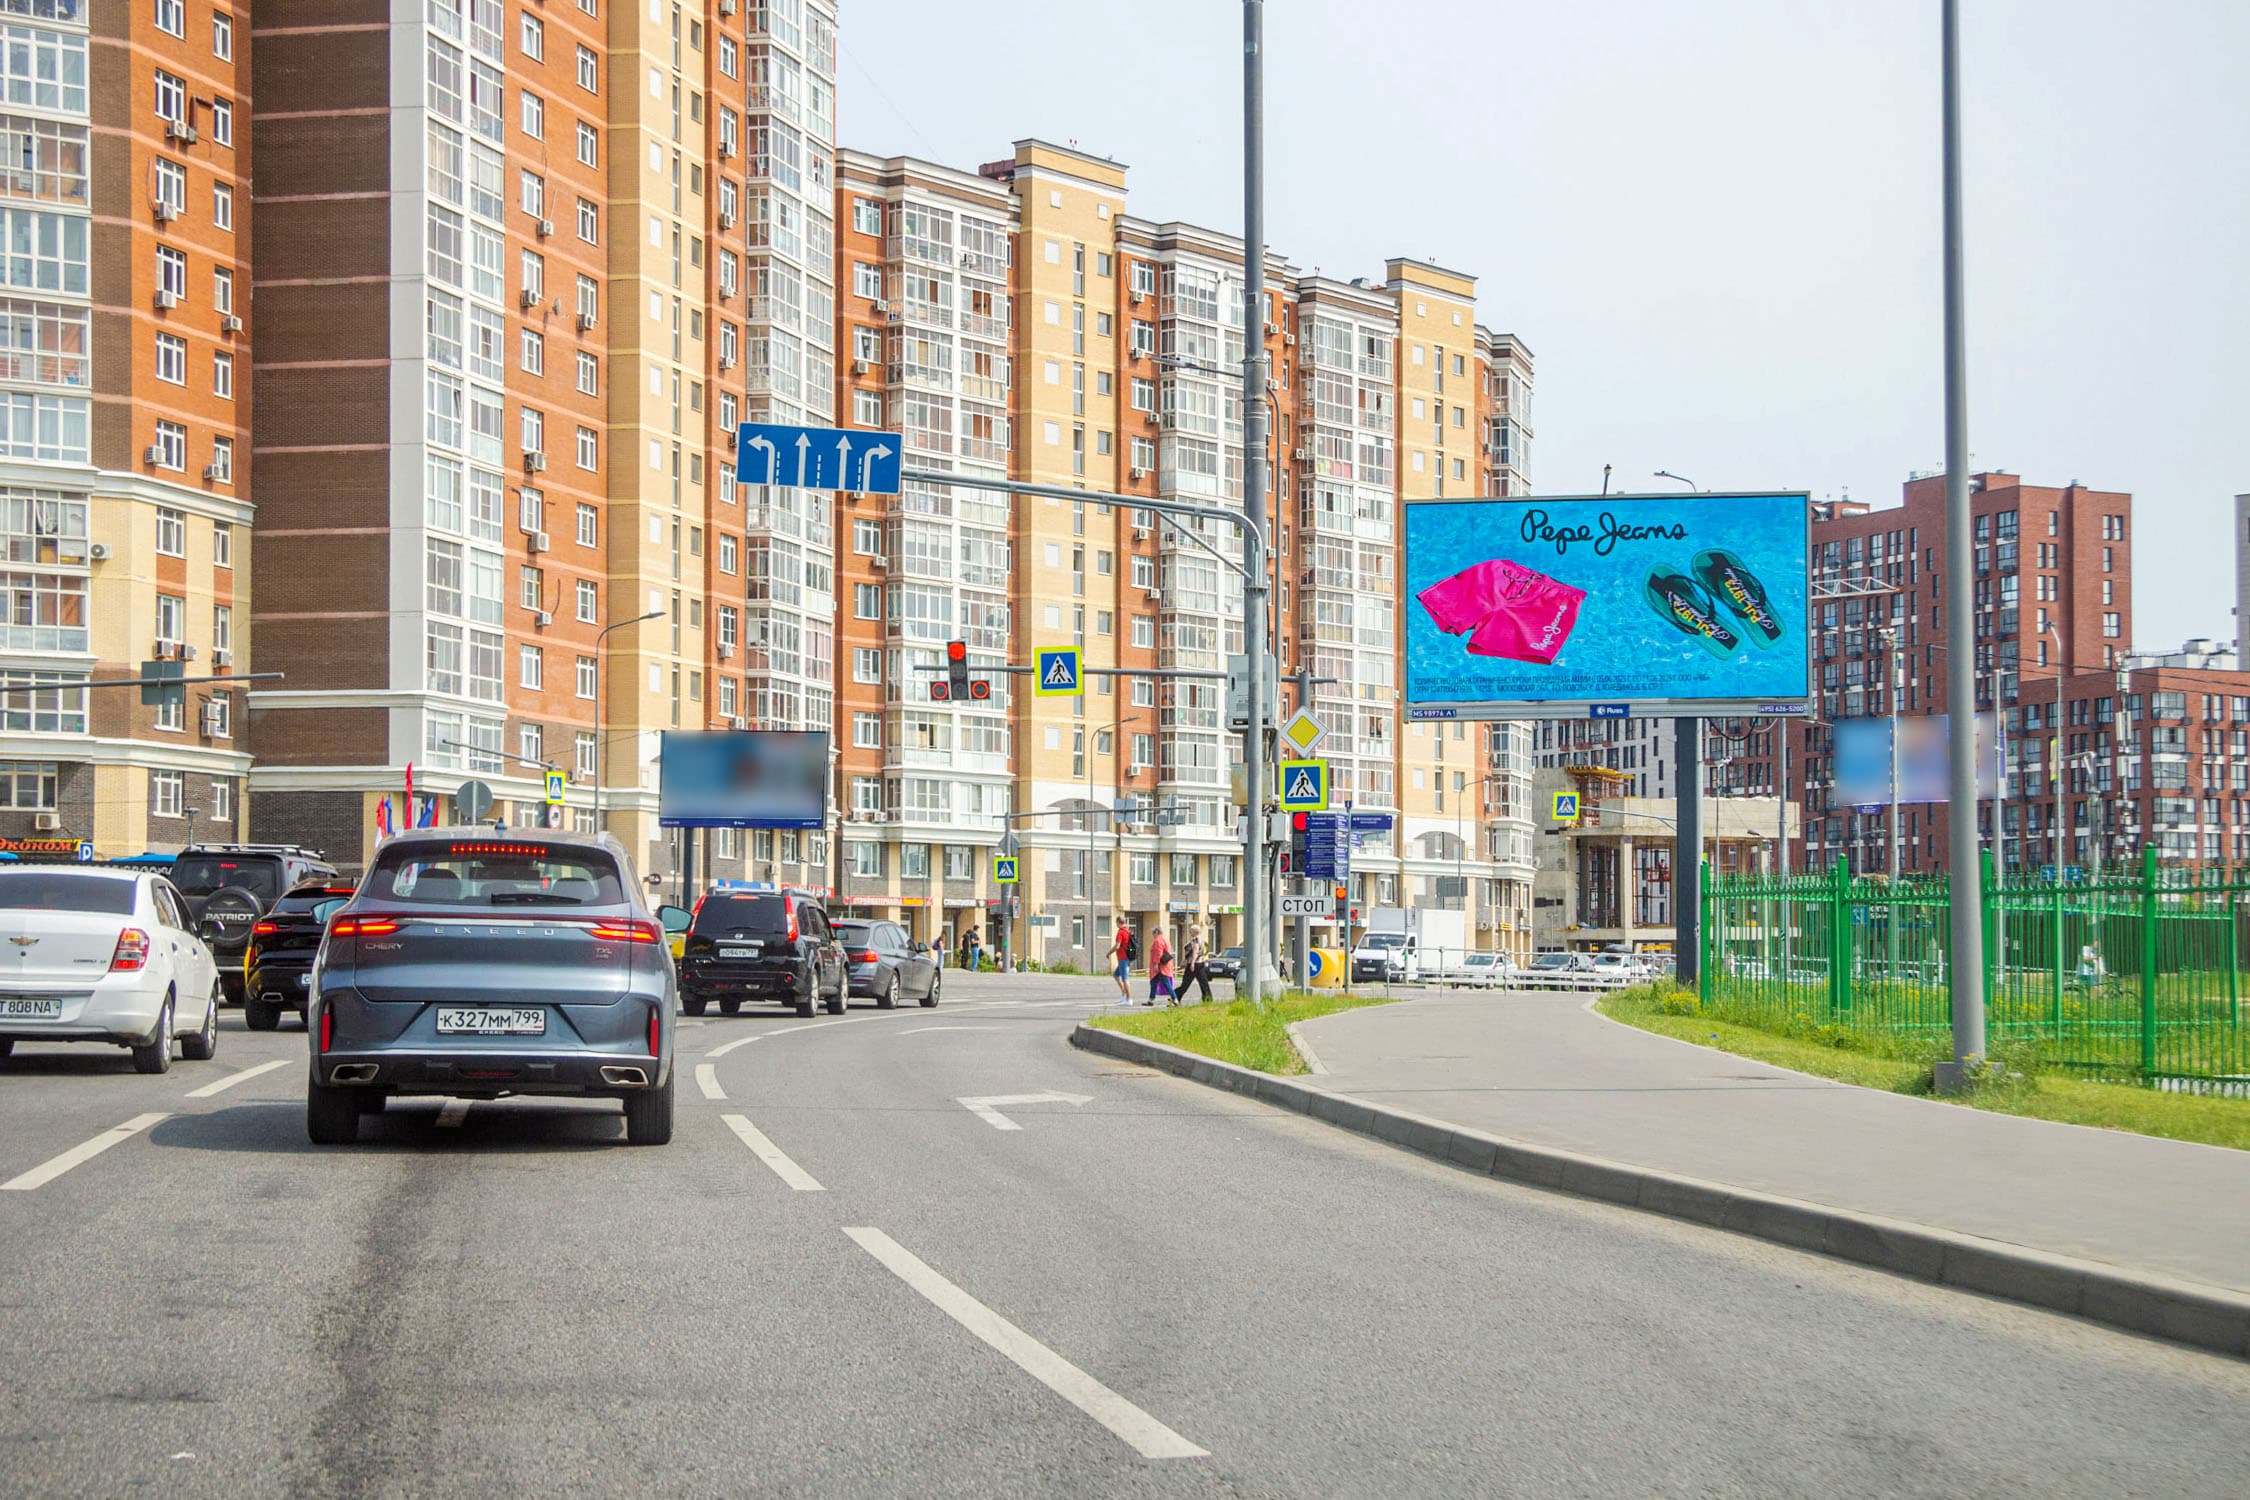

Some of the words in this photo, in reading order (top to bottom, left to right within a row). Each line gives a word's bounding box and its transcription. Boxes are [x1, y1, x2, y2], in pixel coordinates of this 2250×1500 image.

[1521, 509, 1594, 555] Pepe
[1594, 512, 1688, 556] Jeans
[1724, 578, 1746, 604] 1973
[1542, 605, 1567, 635] Jeans
[1606, 706, 1623, 714] Russ
[1283, 899, 1324, 913] СТОП
[434, 927, 555, 936] EXEED
[365, 942, 404, 950] CHERY
[8, 1001, 32, 1013] 808
[33, 1001, 51, 1013] NA
[515, 1011, 541, 1024] 799
